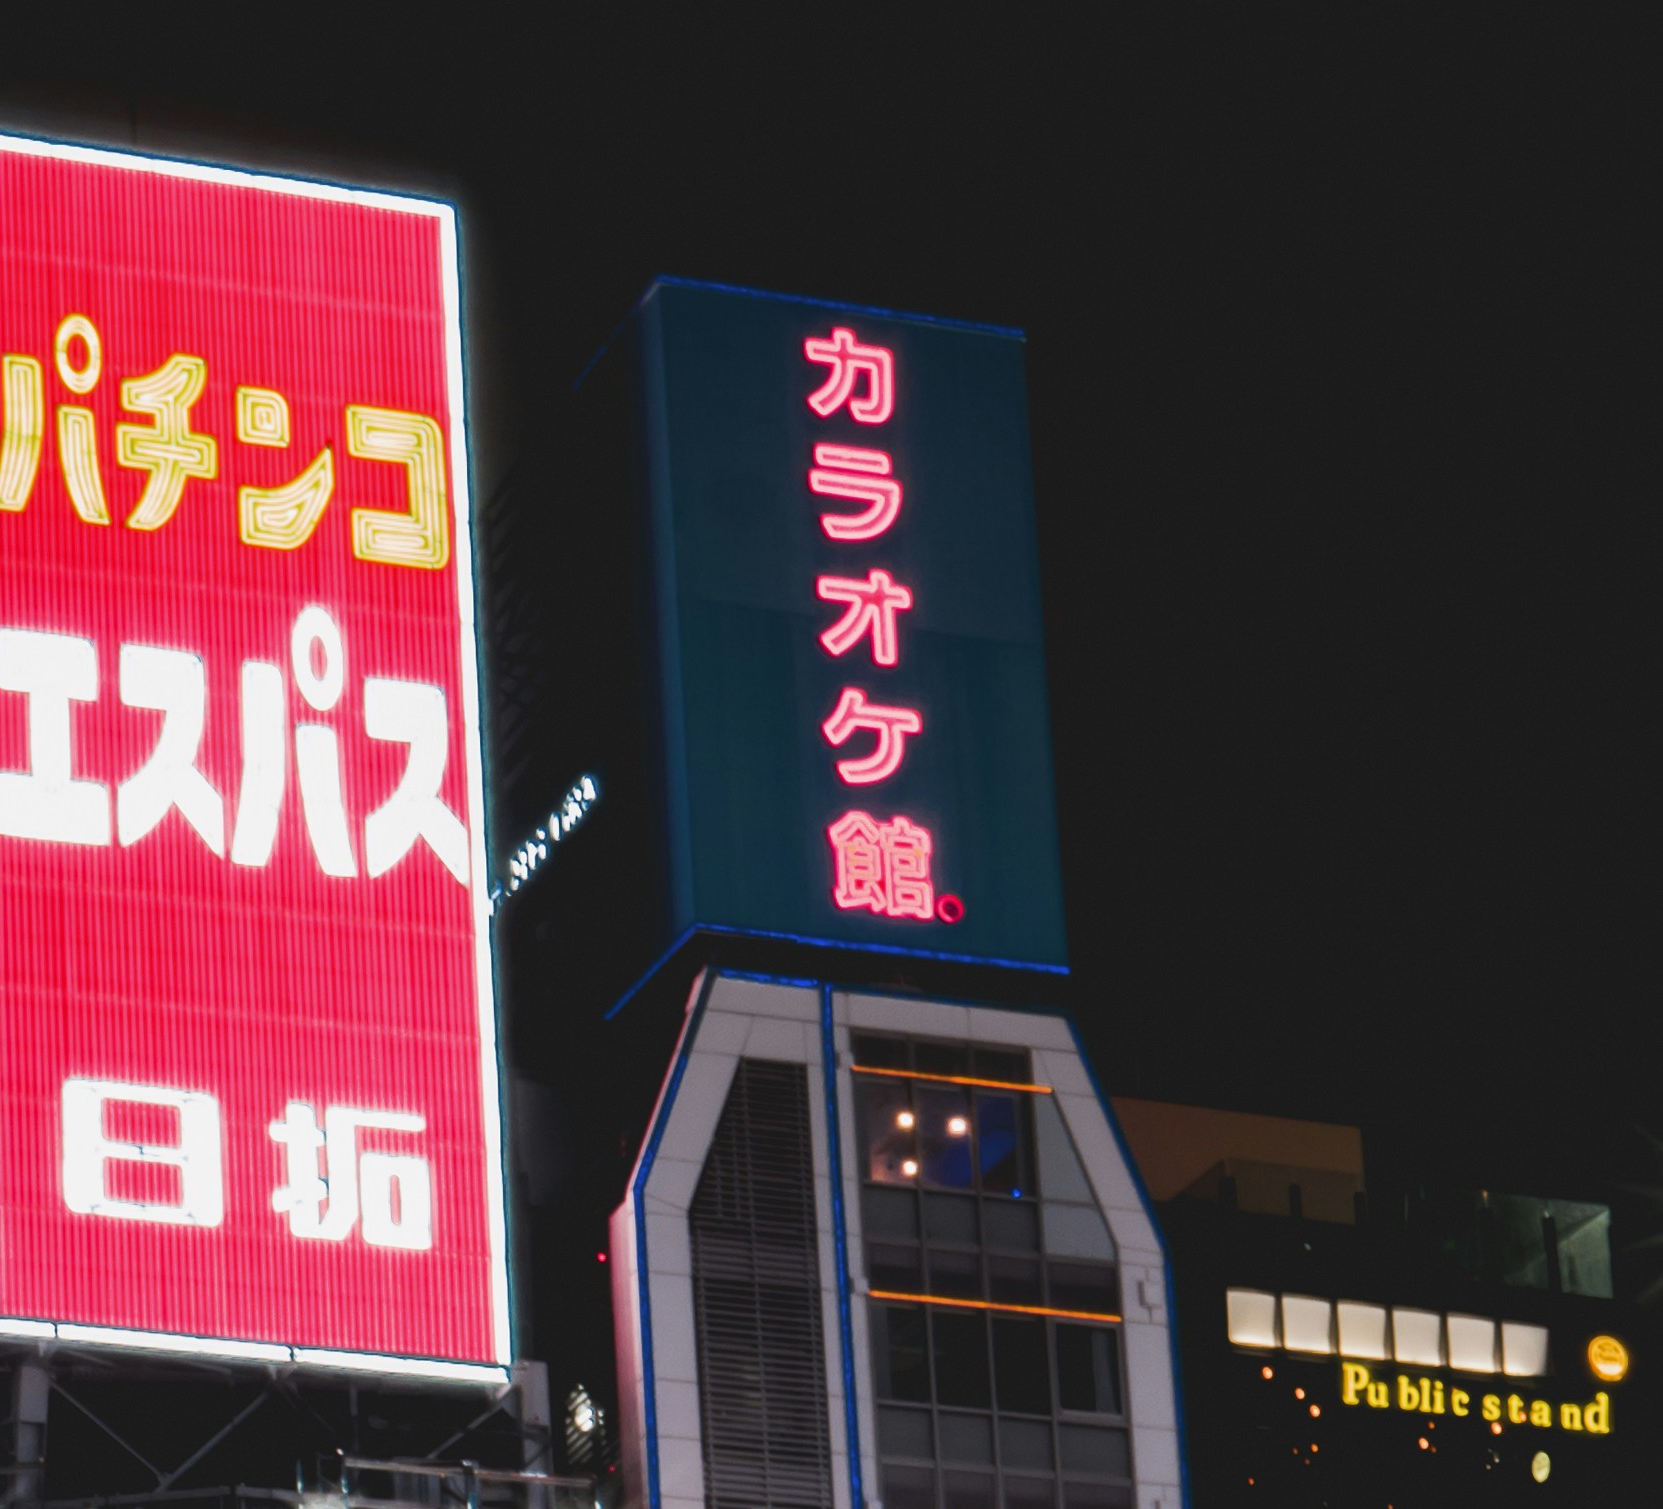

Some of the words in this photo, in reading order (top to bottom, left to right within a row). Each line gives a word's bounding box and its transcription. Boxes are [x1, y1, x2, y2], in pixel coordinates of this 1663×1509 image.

[802, 328, 936, 922] カラオケ館
[60, 1076, 434, 1252] 日拓
[1341, 1361, 1470, 1417] Public
[1482, 1390, 1611, 1434] stand
